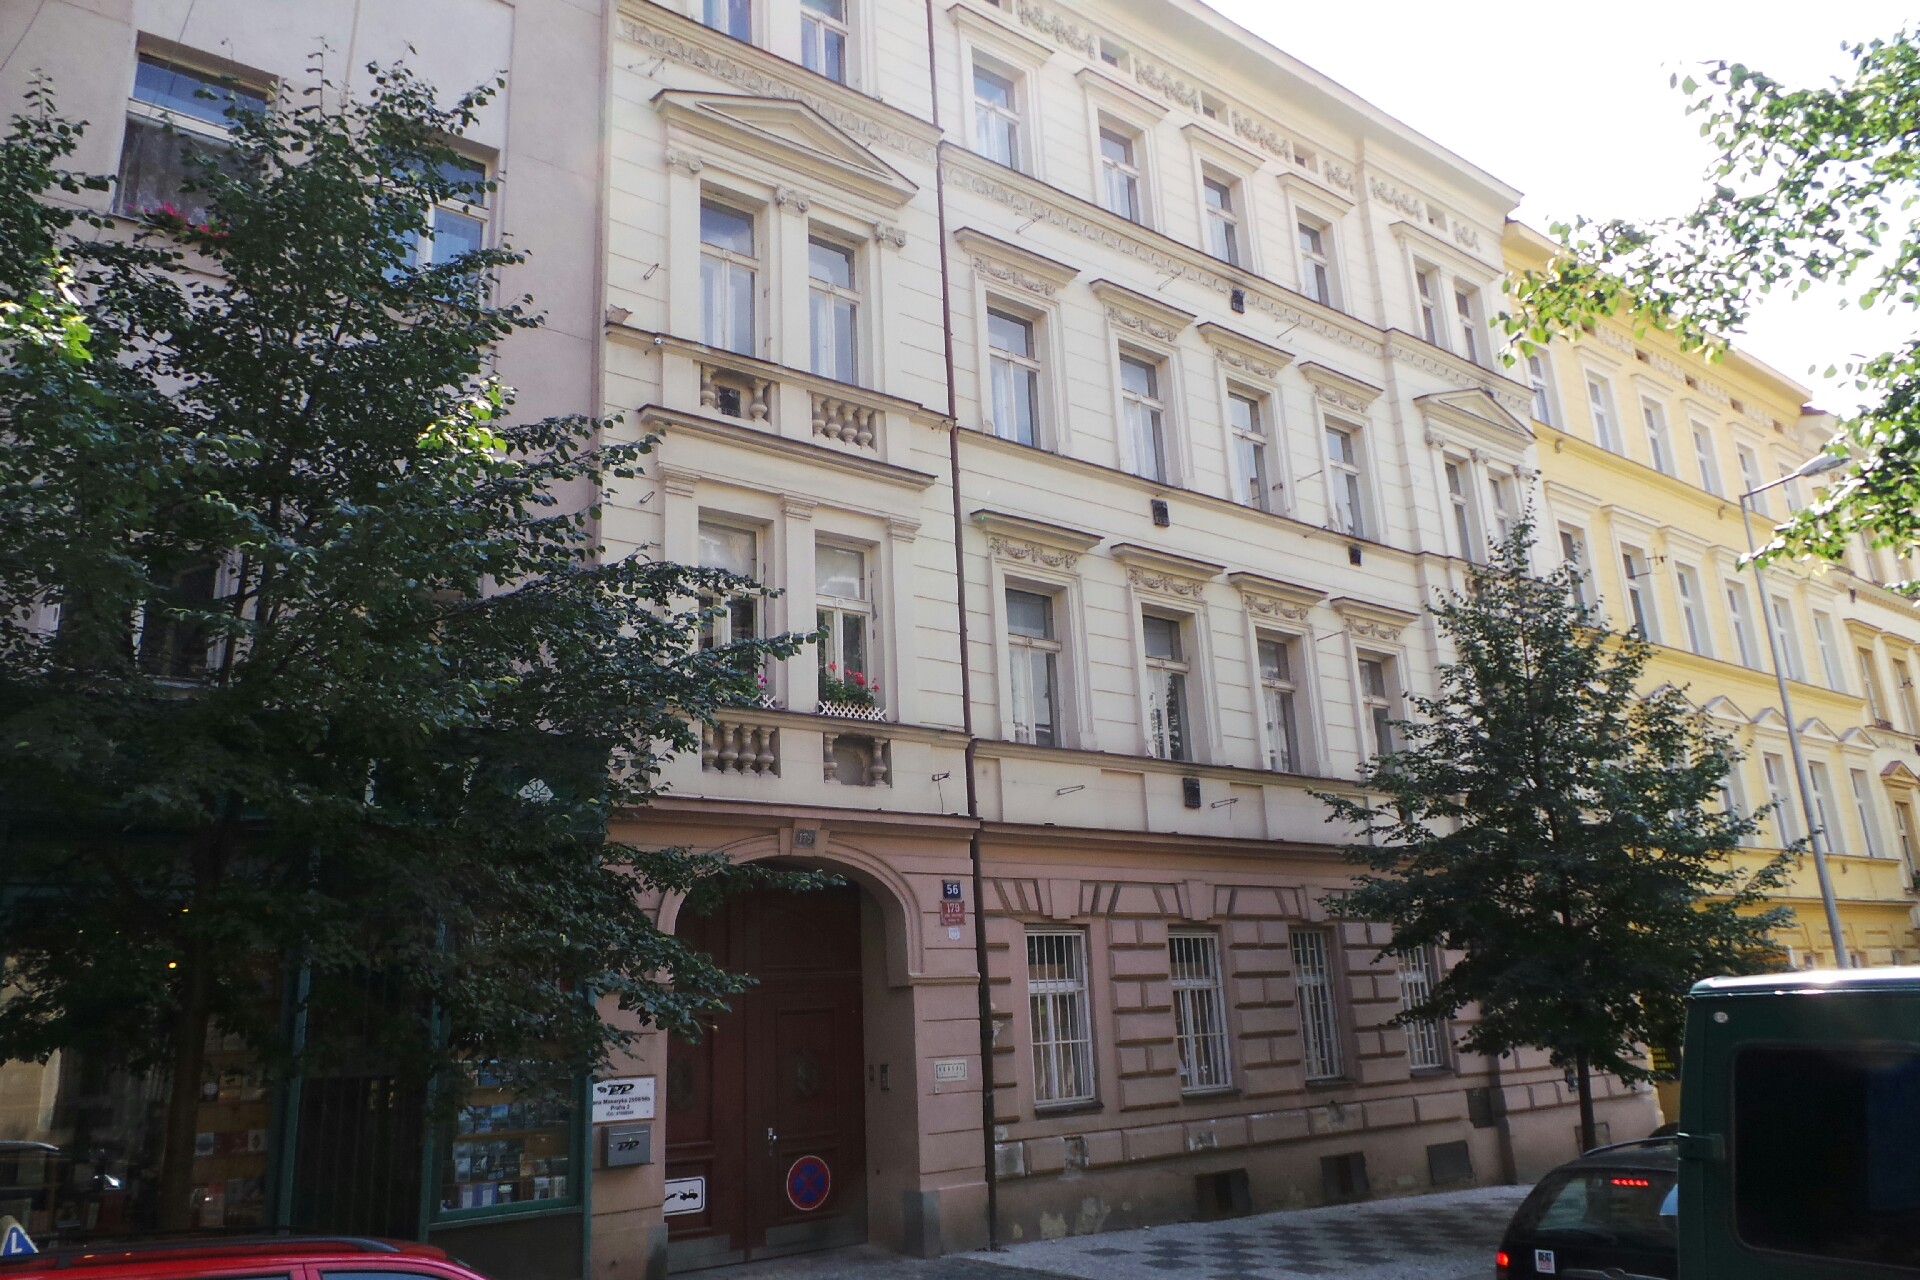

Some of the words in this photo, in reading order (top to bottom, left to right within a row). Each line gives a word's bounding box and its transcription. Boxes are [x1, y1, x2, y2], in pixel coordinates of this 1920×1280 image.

[946, 884, 958, 894] 56
[947, 903, 960, 912] 179
[11, 1232, 23, 1253] L
